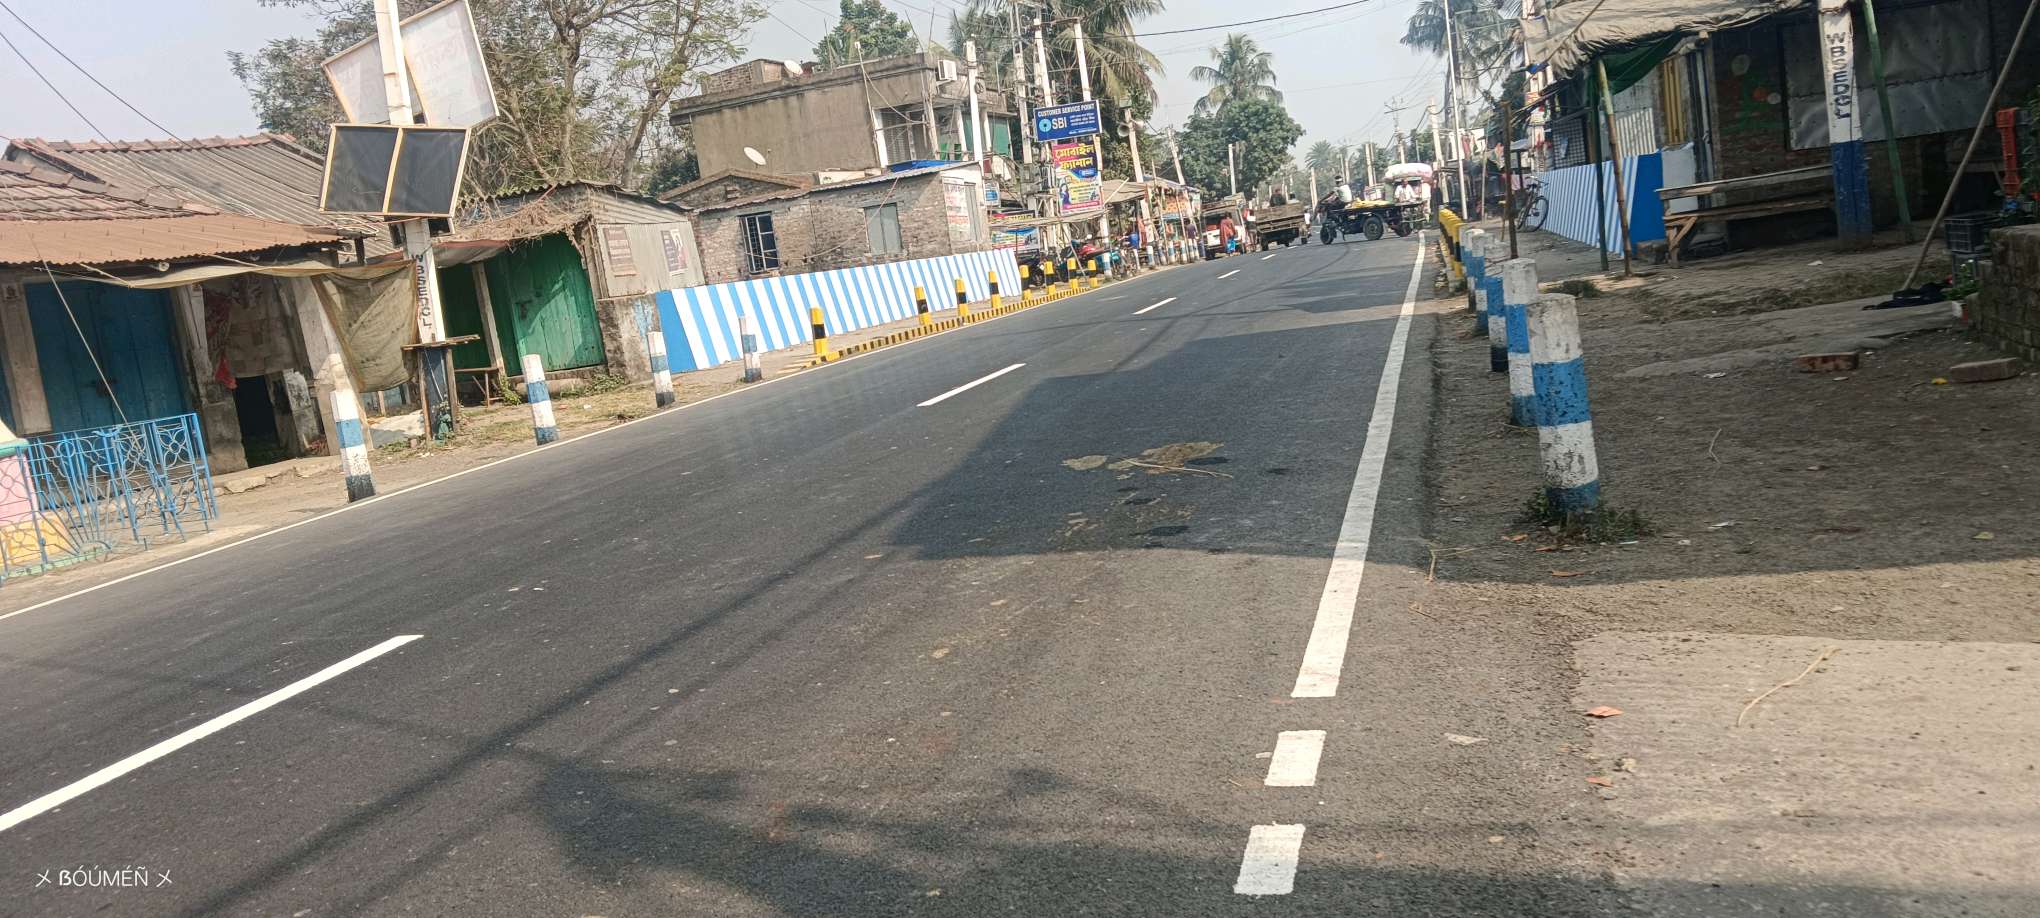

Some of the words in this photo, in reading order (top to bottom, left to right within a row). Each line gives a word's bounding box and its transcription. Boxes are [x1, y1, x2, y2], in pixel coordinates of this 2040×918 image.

[1826, 31, 1851, 119] WBSEDCL
[1037, 108, 1062, 118] CUSTOMER
[1061, 105, 1081, 114] SERVICE
[1080, 103, 1095, 111] POINT
[1052, 116, 1068, 130] SBI
[1055, 142, 1095, 161] মোবাইল
